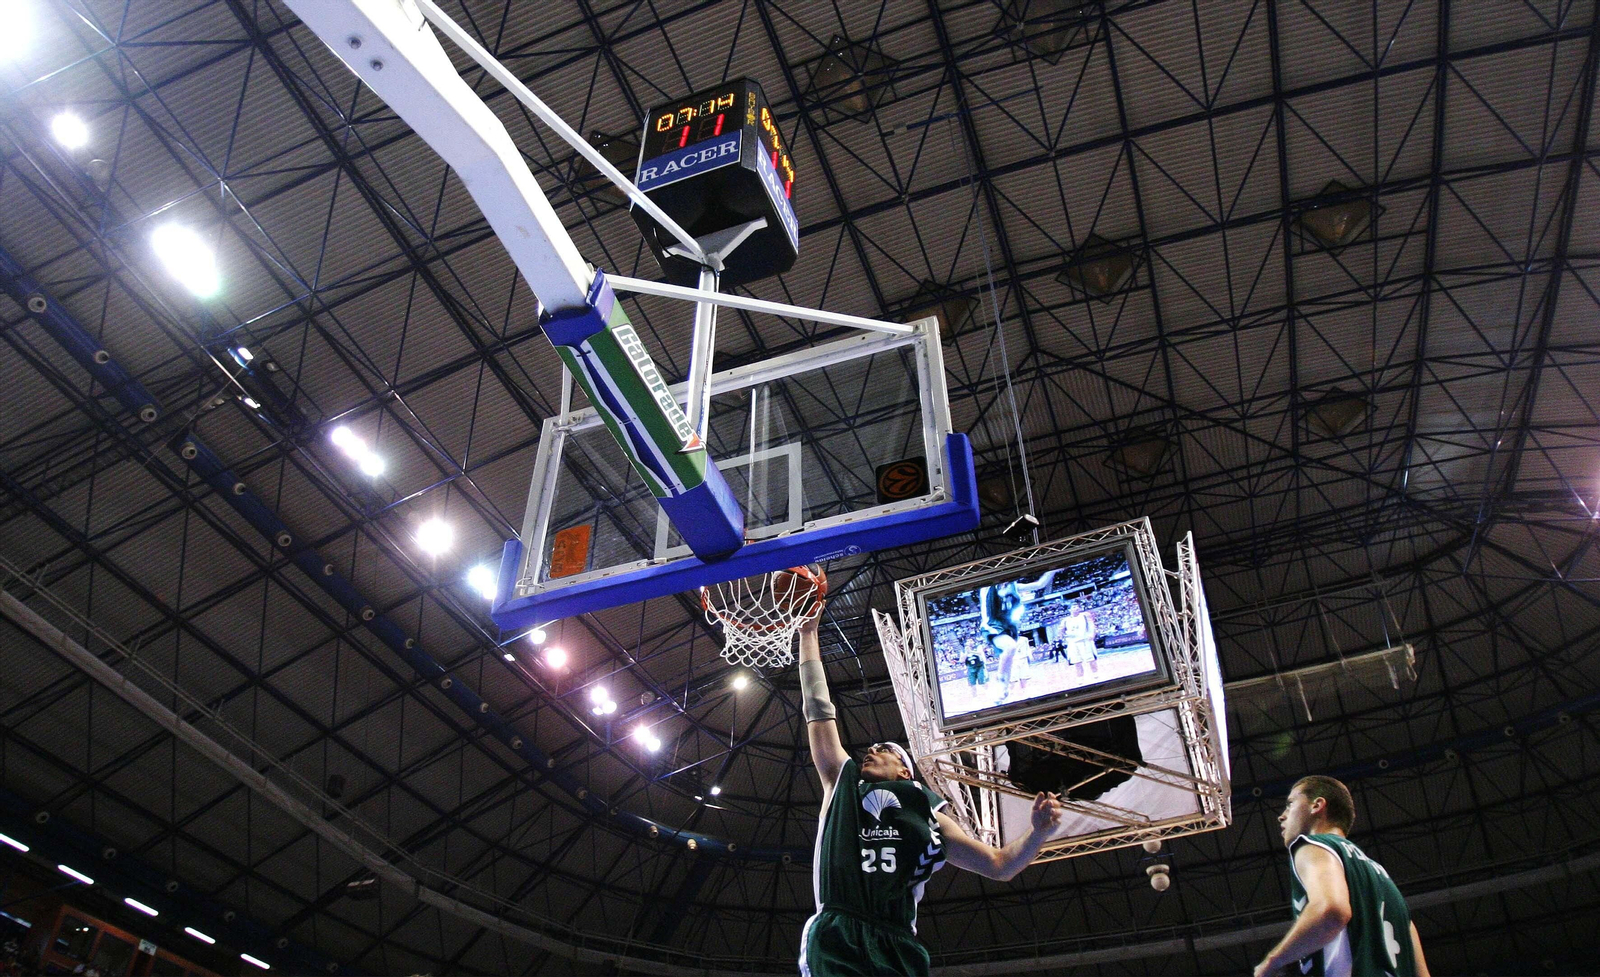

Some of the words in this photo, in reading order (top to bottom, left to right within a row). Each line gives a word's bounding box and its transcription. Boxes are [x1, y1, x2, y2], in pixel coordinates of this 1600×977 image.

[657, 93, 734, 132] 07:14
[639, 140, 739, 184] RACER
[758, 146, 797, 239] RACER
[613, 326, 694, 441] Gatorade
[861, 825, 900, 838] Unicaja
[861, 847, 897, 873] 25
